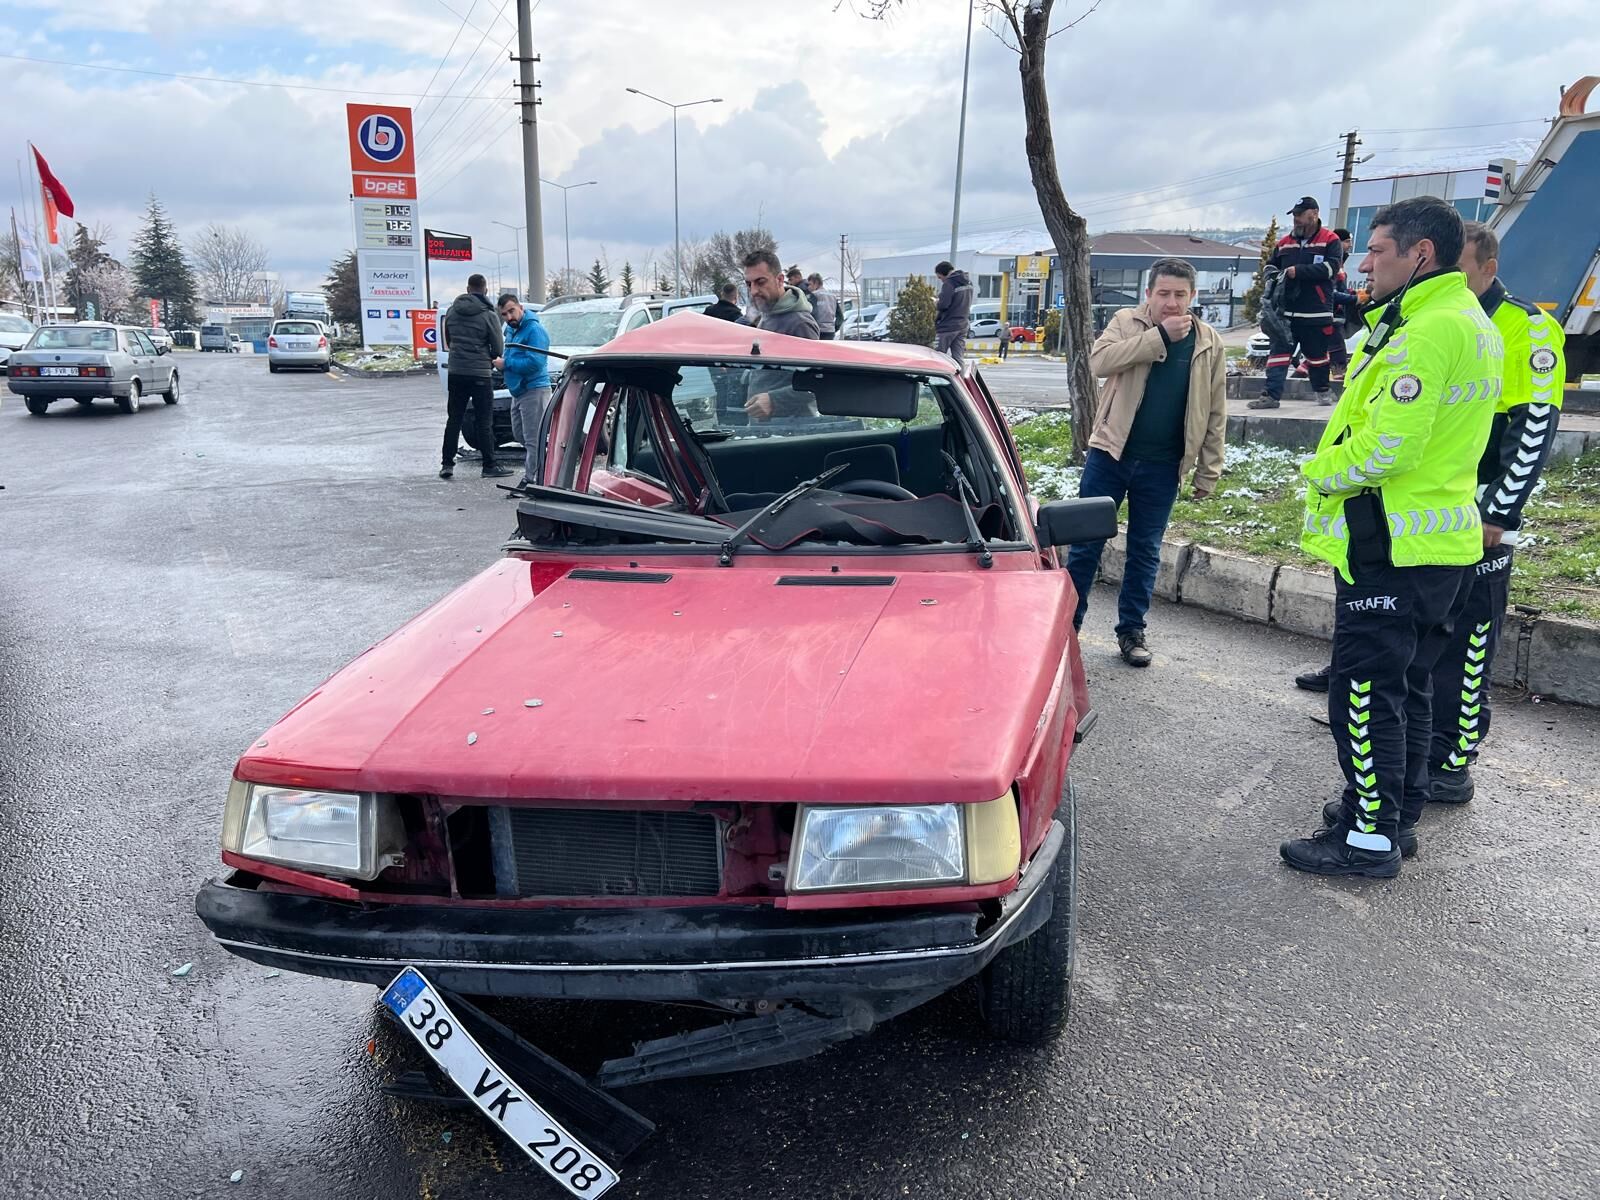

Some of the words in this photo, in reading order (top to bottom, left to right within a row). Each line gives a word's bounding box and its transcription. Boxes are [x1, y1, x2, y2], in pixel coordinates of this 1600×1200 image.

[365, 179, 406, 193] bpet
[373, 272, 408, 280] Market
[1346, 595, 1398, 612] TRAFİK
[392, 992, 407, 1008] TR
[409, 998, 453, 1050] 38
[472, 1067, 523, 1122] VK
[527, 1127, 602, 1192] 208
